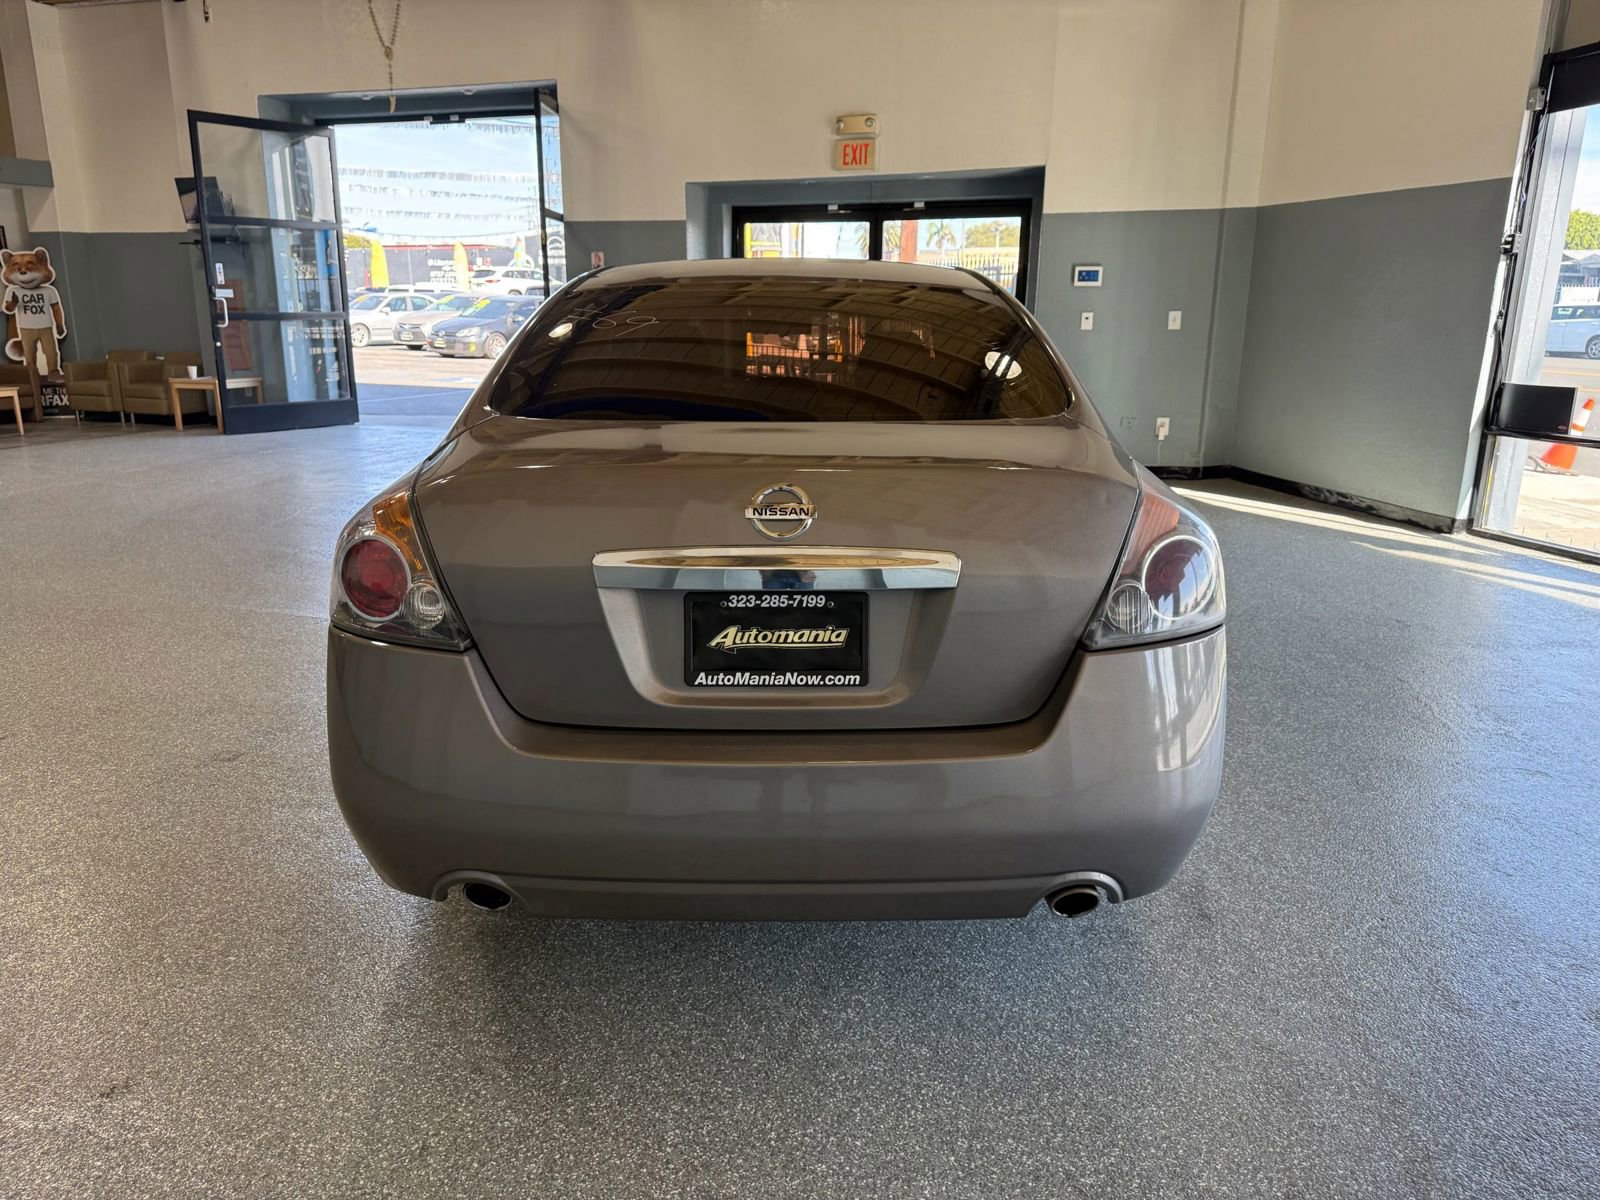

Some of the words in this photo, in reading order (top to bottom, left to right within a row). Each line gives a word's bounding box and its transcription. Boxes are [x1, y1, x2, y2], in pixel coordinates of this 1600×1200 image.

[843, 143, 869, 166] EXIT
[22, 293, 45, 304] CAR
[23, 304, 46, 315] FOX
[752, 507, 811, 516] NISSAN
[728, 595, 826, 608] 323-285-7199
[706, 624, 850, 650] Automania
[694, 672, 861, 686] AutoManiaNow.com
